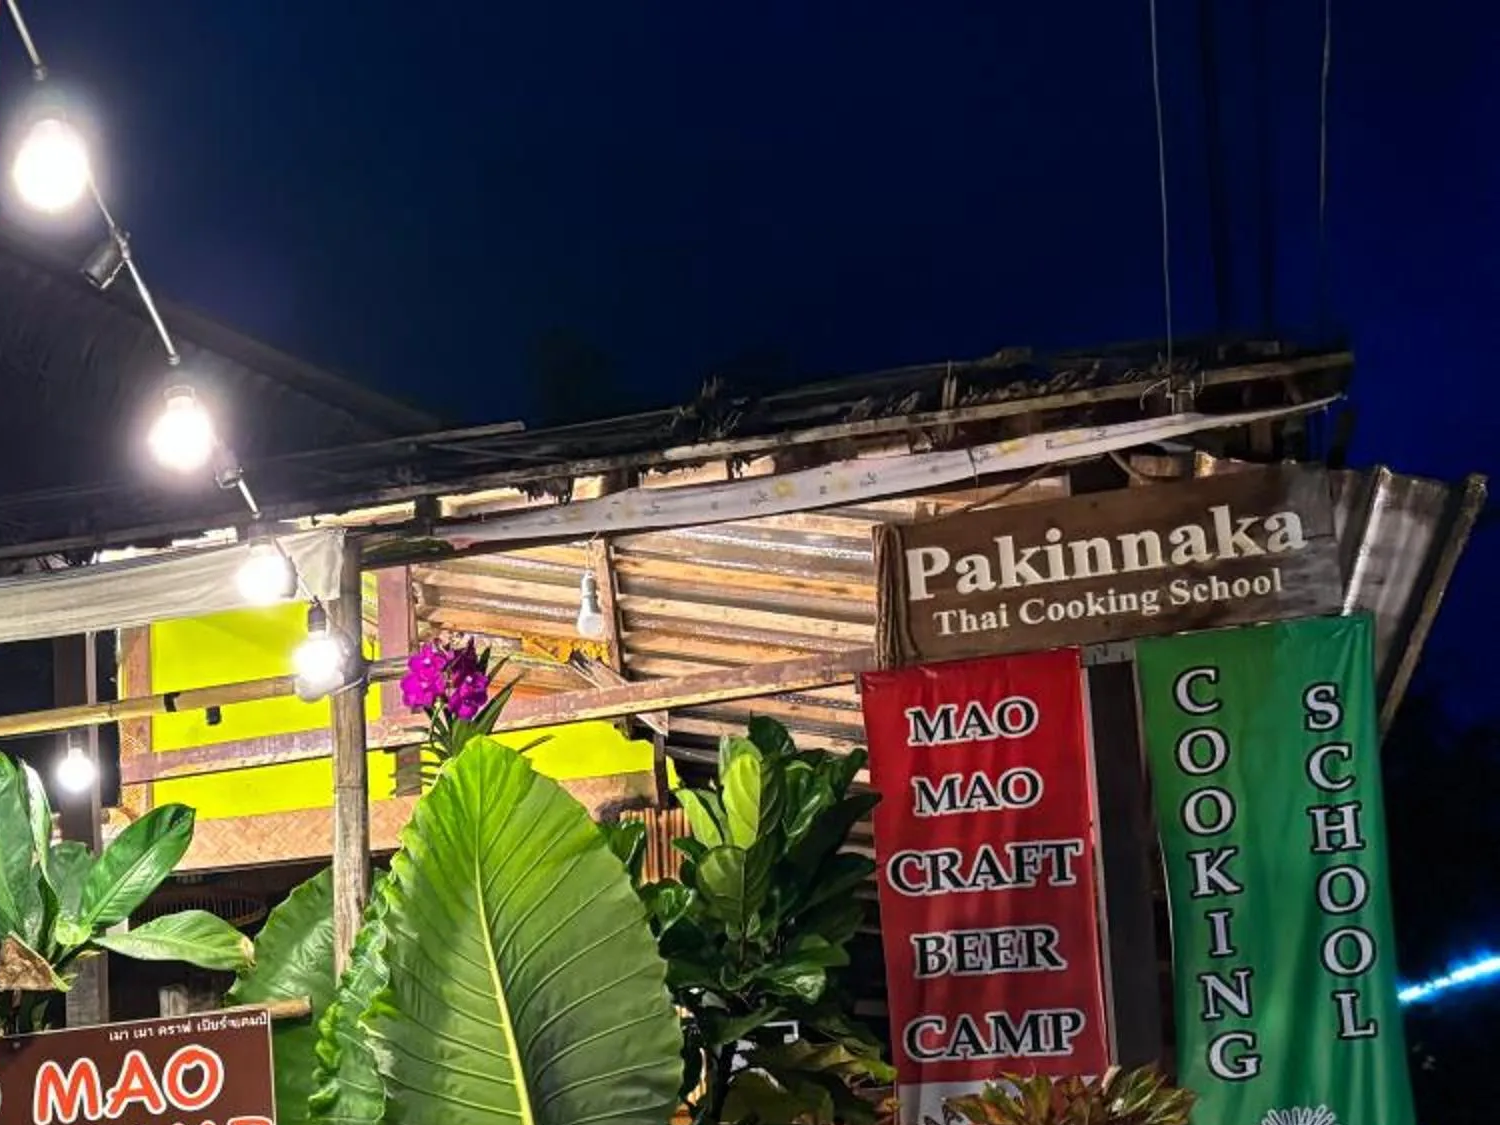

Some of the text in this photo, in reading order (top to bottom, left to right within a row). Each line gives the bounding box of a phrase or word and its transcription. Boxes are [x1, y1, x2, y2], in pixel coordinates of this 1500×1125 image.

[905, 505, 1308, 602] Pakinnaka
[933, 567, 1283, 636] Thai Cooking School
[905, 696, 1040, 747] MAO
[911, 766, 1045, 819] MAO
[886, 838, 1085, 896] CRAFT
[1172, 665, 1263, 1082] COOKING
[1302, 682, 1379, 1041] SCHOOL
[910, 924, 1069, 980] BEER
[902, 1008, 1087, 1062] CAMP
